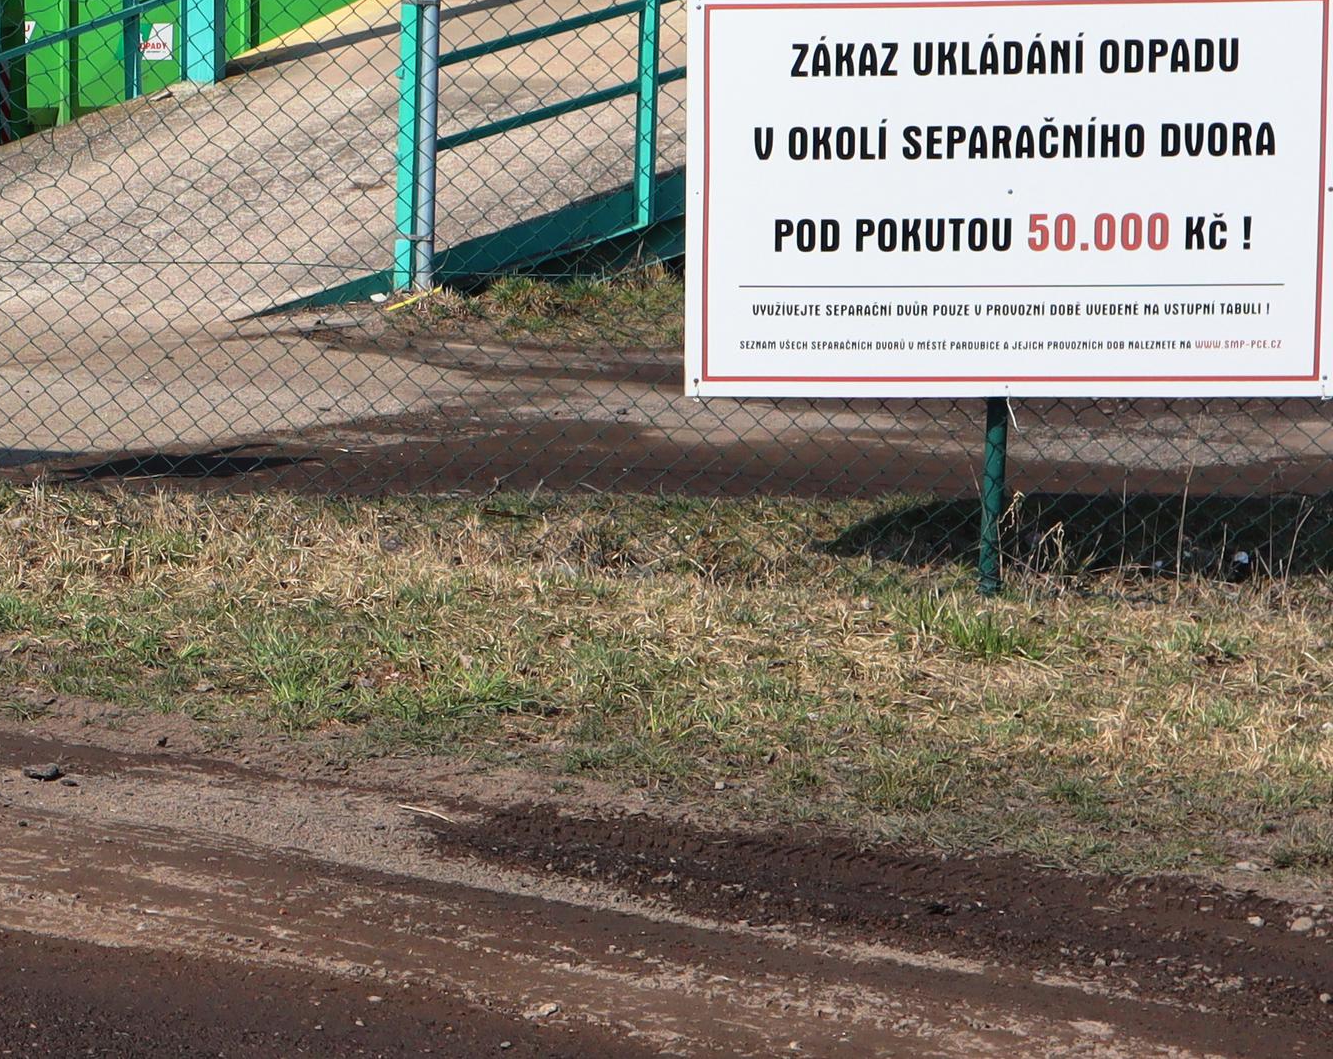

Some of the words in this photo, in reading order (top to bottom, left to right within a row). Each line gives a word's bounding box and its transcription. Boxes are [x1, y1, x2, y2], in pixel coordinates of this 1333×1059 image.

[791, 36, 898, 77] ZÁKAZ
[914, 32, 1083, 76] UKLÁDÁNÍ
[1100, 38, 1238, 73] ODPADU
[754, 127, 773, 160] V
[789, 119, 886, 160] OKOLÍ
[903, 117, 1144, 160] SEPARAČNÍHO
[1161, 122, 1275, 157] DVORA
[775, 219, 839, 252] POD
[856, 218, 1011, 252] POKUTOU
[1028, 213, 1169, 251] 50.000
[1243, 216, 1251, 249] !
[753, 302, 820, 316] VYUŽÍVEJTE
[826, 302, 891, 316] SEPARAČNÍ
[897, 301, 927, 316] DVŮR
[933, 305, 969, 316] POUZE
[975, 305, 981, 316] V
[987, 302, 1044, 316] PROVOZNÍ
[1050, 302, 1080, 315] DOBĚ
[1144, 304, 1159, 315] NA
[1164, 301, 1214, 315] VSTUPNÍ
[1220, 303, 1261, 314] TABULI
[1267, 303, 1269, 314] !
[740, 341, 776, 349] SEZNAM
[780, 340, 807, 349] VŠECH
[811, 340, 872, 350] SEPARAČNÍCH
[876, 339, 905, 350] DVORŮ
[909, 342, 913, 350] V
[917, 340, 946, 350] MĚSTĚ
[950, 341, 999, 350] PARDUBICE
[1004, 341, 1008, 350] A
[1012, 341, 1043, 350] JEJICH
[1047, 340, 1103, 350] PROVOZNÍCH
[1107, 341, 1124, 349] DOB
[1128, 341, 1175, 349] NALEZNETE
[1180, 341, 1191, 349] NA
[1195, 340, 1281, 348] WWW.SMP-PCE.CZ
